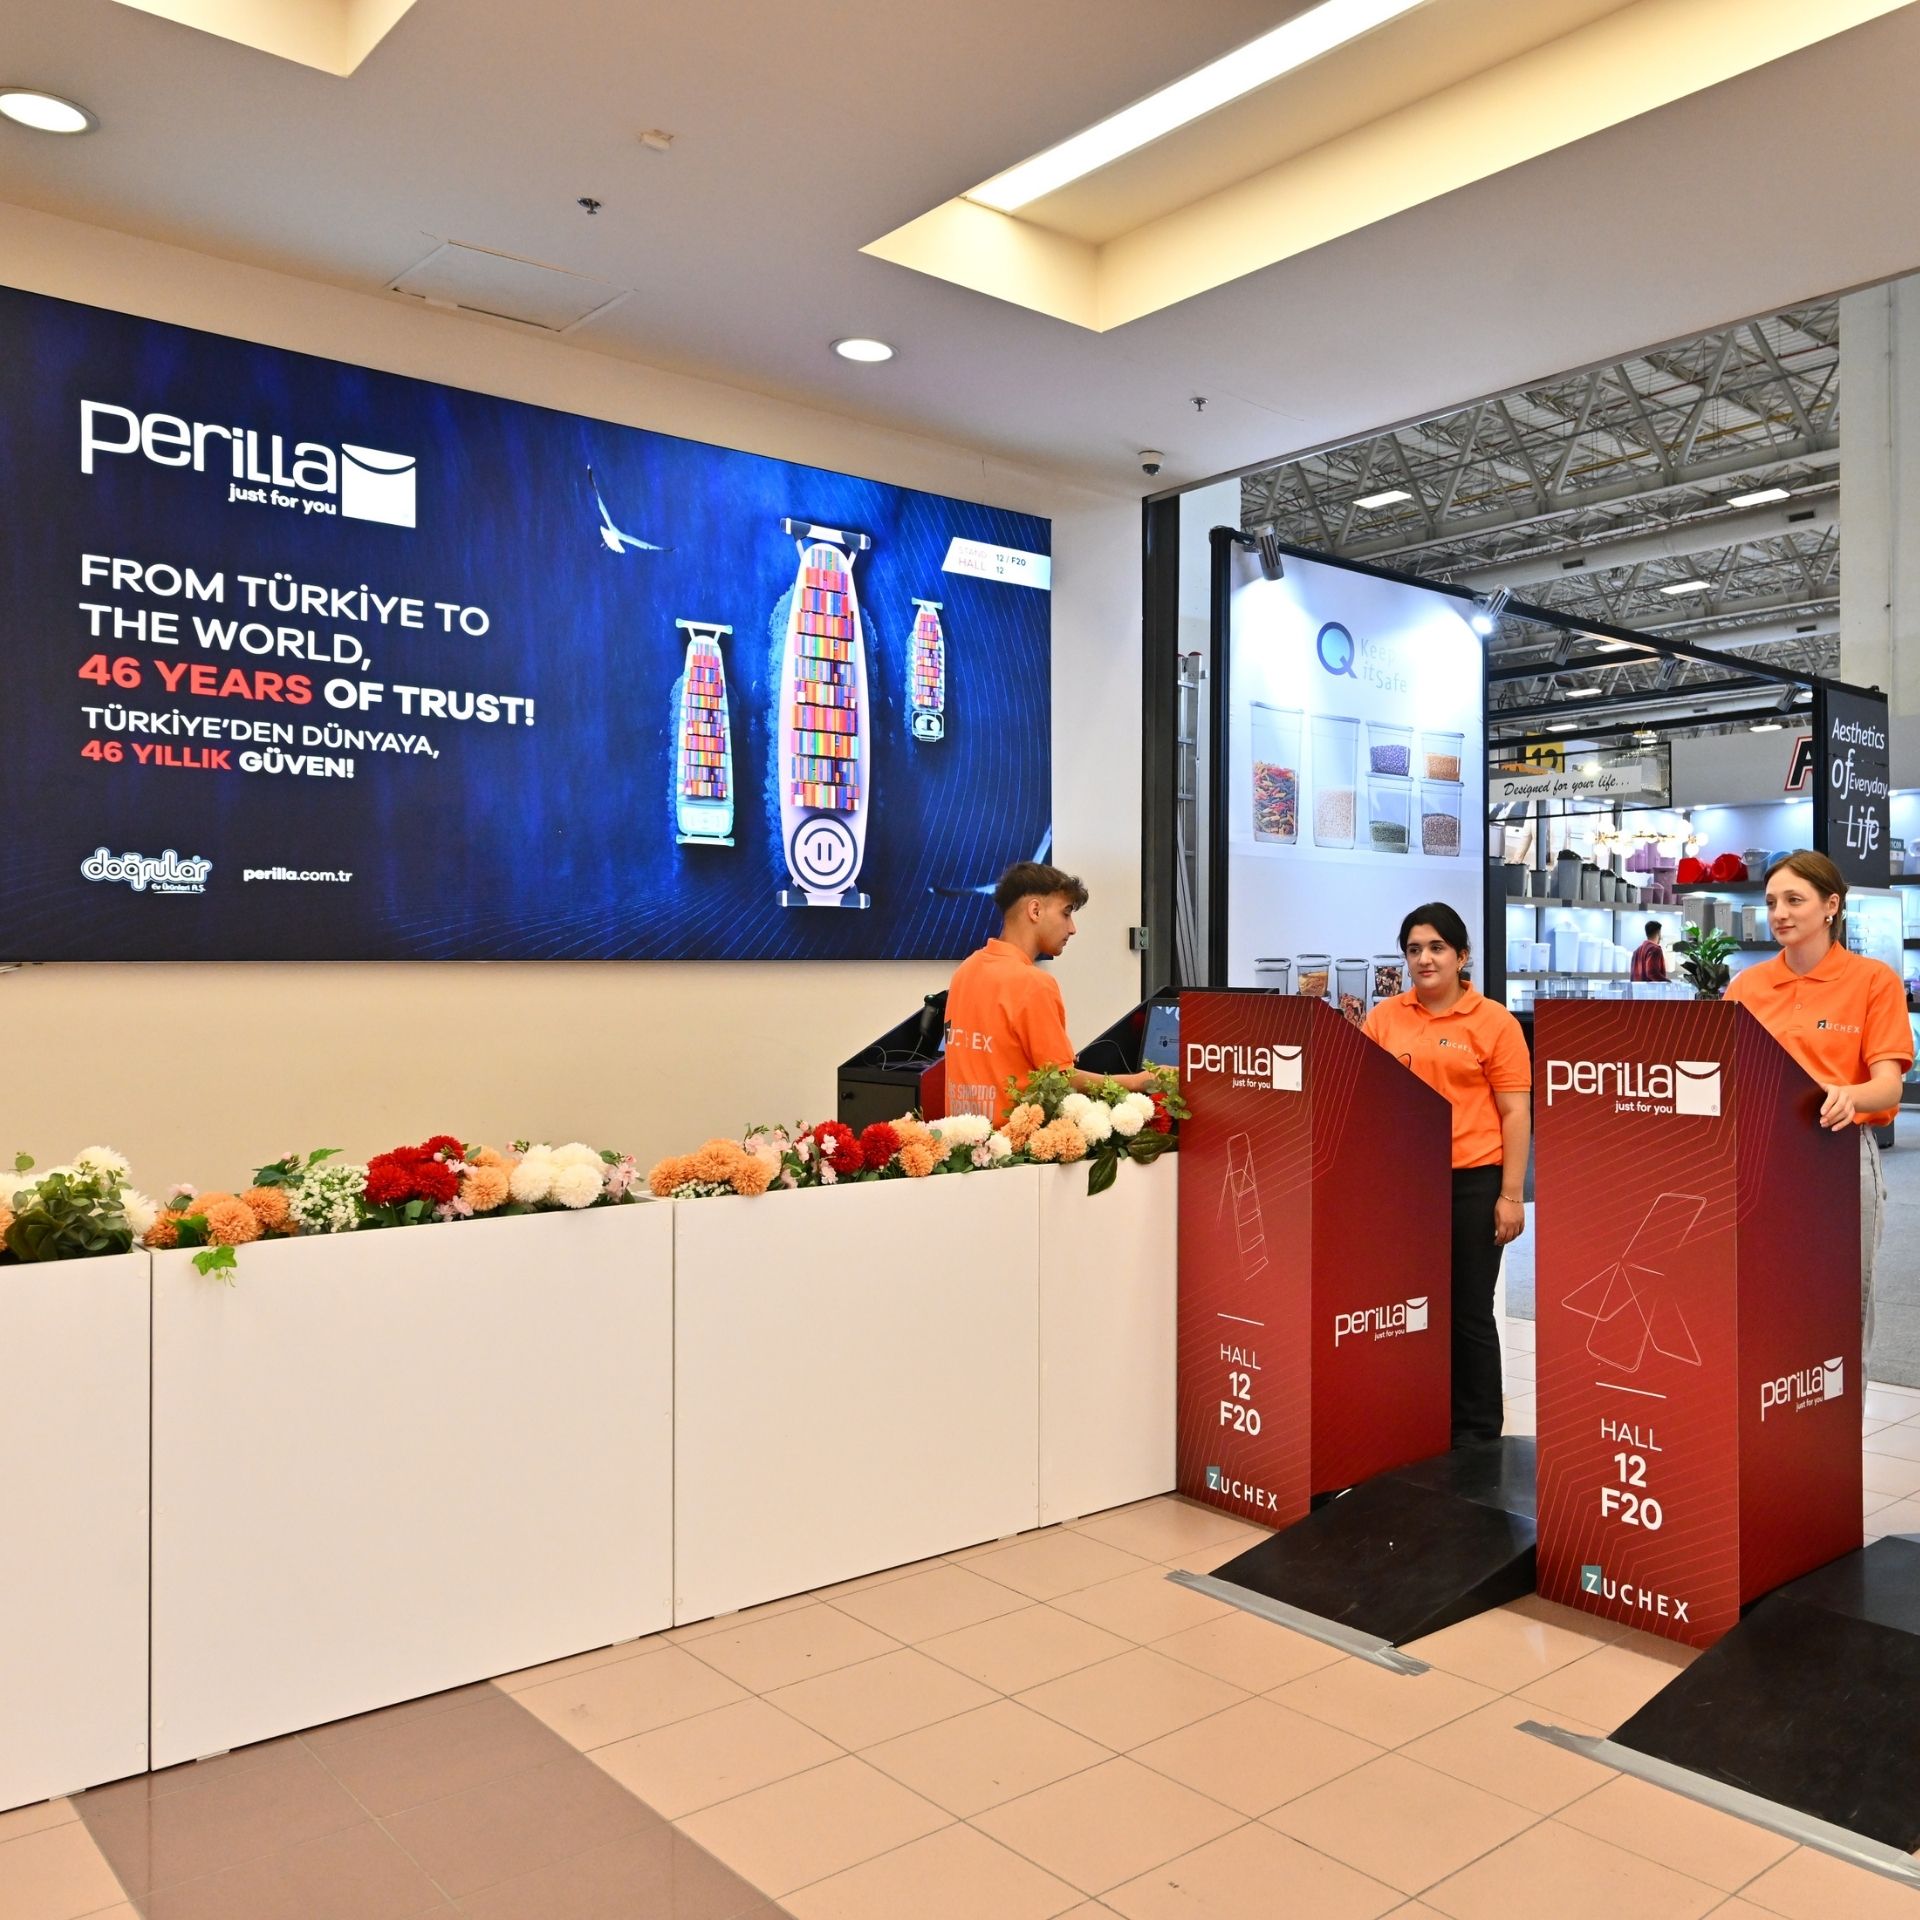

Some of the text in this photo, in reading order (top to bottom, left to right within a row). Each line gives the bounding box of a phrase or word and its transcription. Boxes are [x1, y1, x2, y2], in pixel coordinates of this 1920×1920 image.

[81, 399, 337, 494] perilla
[228, 483, 337, 515] just for you
[958, 556, 1004, 575] HALL 12
[996, 553, 1004, 562] 12
[1011, 556, 1027, 567] F20
[81, 553, 490, 637] FROM TÜRKİYE TO
[79, 602, 371, 672] THE WORLD,
[1316, 621, 1358, 680] Q
[78, 654, 536, 727] 46 YEARS OF TRUST!
[80, 703, 440, 760] TÜRKİYE'DEN DÜNYAYA,
[1832, 717, 1885, 750] Aesthetics
[80, 738, 356, 780] 46 YILLIK GÜVEN!
[1831, 748, 1888, 800] of Everyday
[1503, 779, 1550, 799] Designed
[1552, 779, 1568, 796] for
[1571, 780, 1595, 793] your
[1846, 804, 1880, 861] Life
[81, 846, 213, 892] doğrular
[243, 866, 353, 883] perilla.com.tr
[1817, 1020, 1861, 1034] ZUCHEX
[1187, 1043, 1271, 1083] perilla
[1546, 1060, 1673, 1106] perilla
[1232, 1078, 1271, 1091] just for you
[1614, 1100, 1673, 1116] just for you
[1335, 1303, 1405, 1348] perilla
[1374, 1328, 1405, 1341] just for you
[1220, 1343, 1262, 1371] HALL
[1229, 1371, 1251, 1400] 12
[1761, 1366, 1823, 1422] perilla
[1220, 1400, 1262, 1436] F20
[1601, 1418, 1662, 1452] HALL
[1614, 1452, 1647, 1488] 12
[1208, 1471, 1278, 1512] ZUCHEX
[1601, 1487, 1663, 1531] F20
[1585, 1572, 1690, 1623] ZUCHEX
